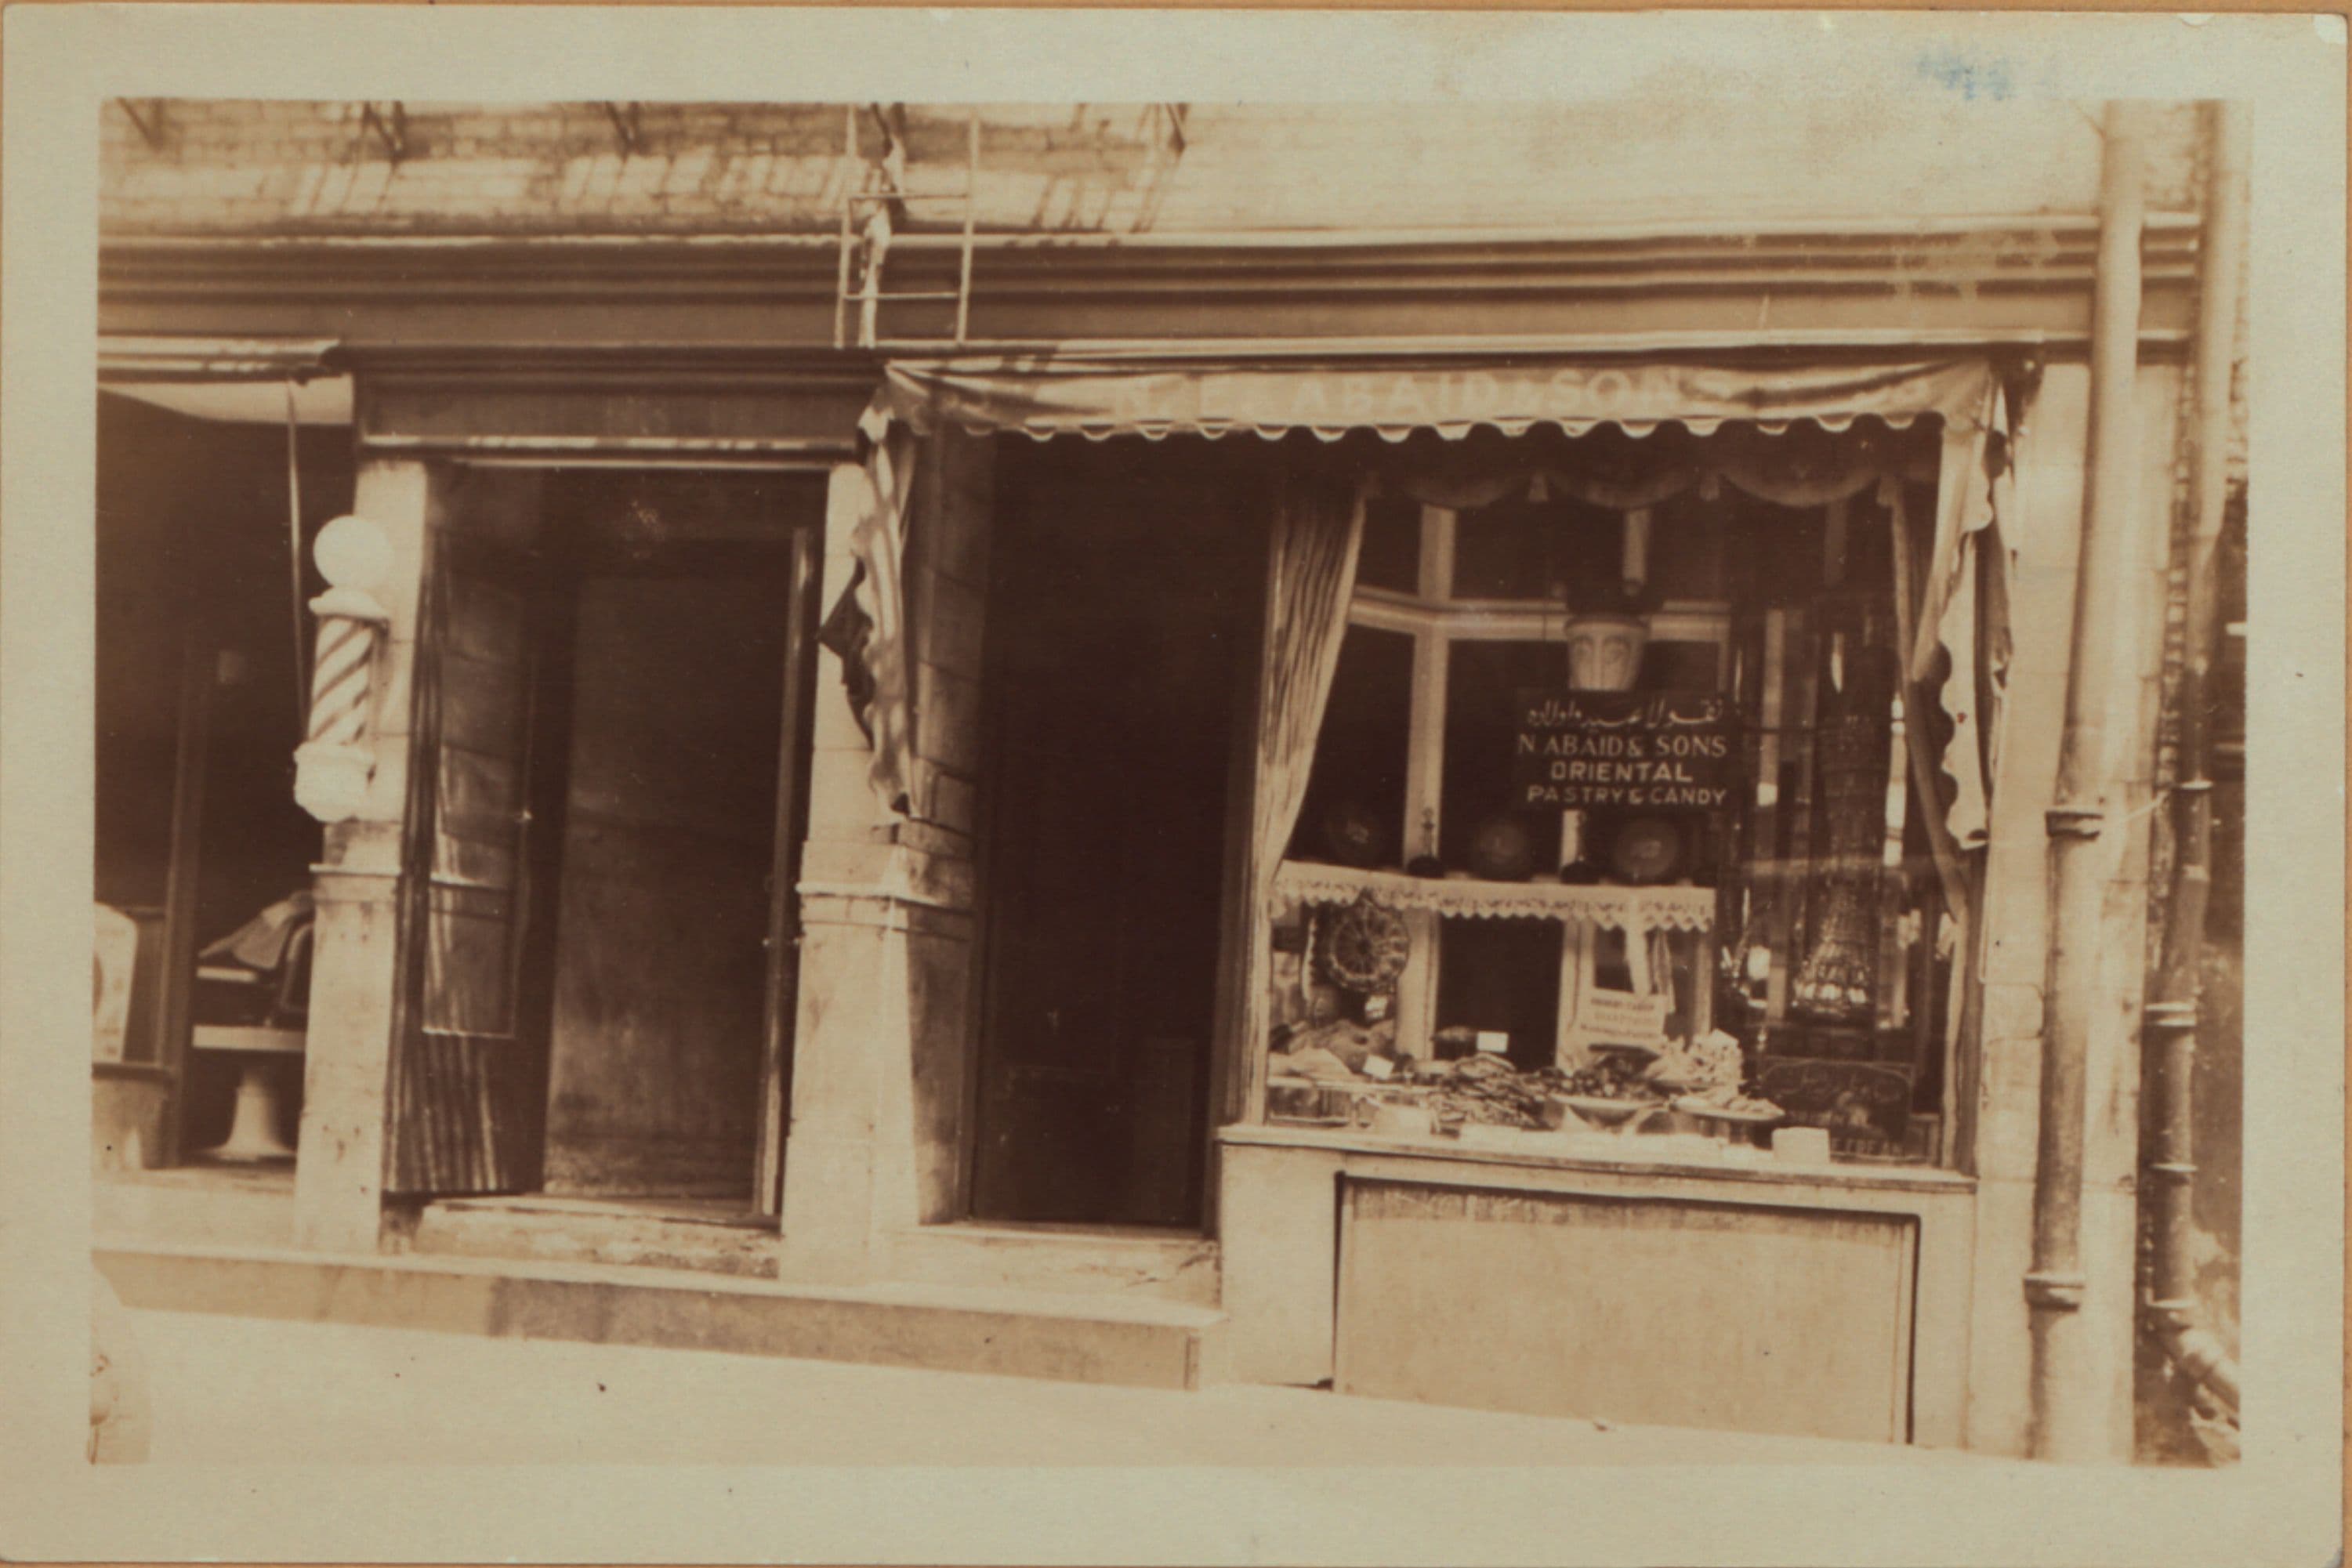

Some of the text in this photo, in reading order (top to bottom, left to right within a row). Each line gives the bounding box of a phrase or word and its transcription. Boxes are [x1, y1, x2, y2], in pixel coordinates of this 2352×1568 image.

[1544, 734, 1623, 756] ABAID
[1655, 735, 1727, 758] SONS
[1550, 760, 1693, 783] ORIENTAL
[1527, 784, 1624, 804] PASTRY
[1650, 787, 1727, 806] CANDY
